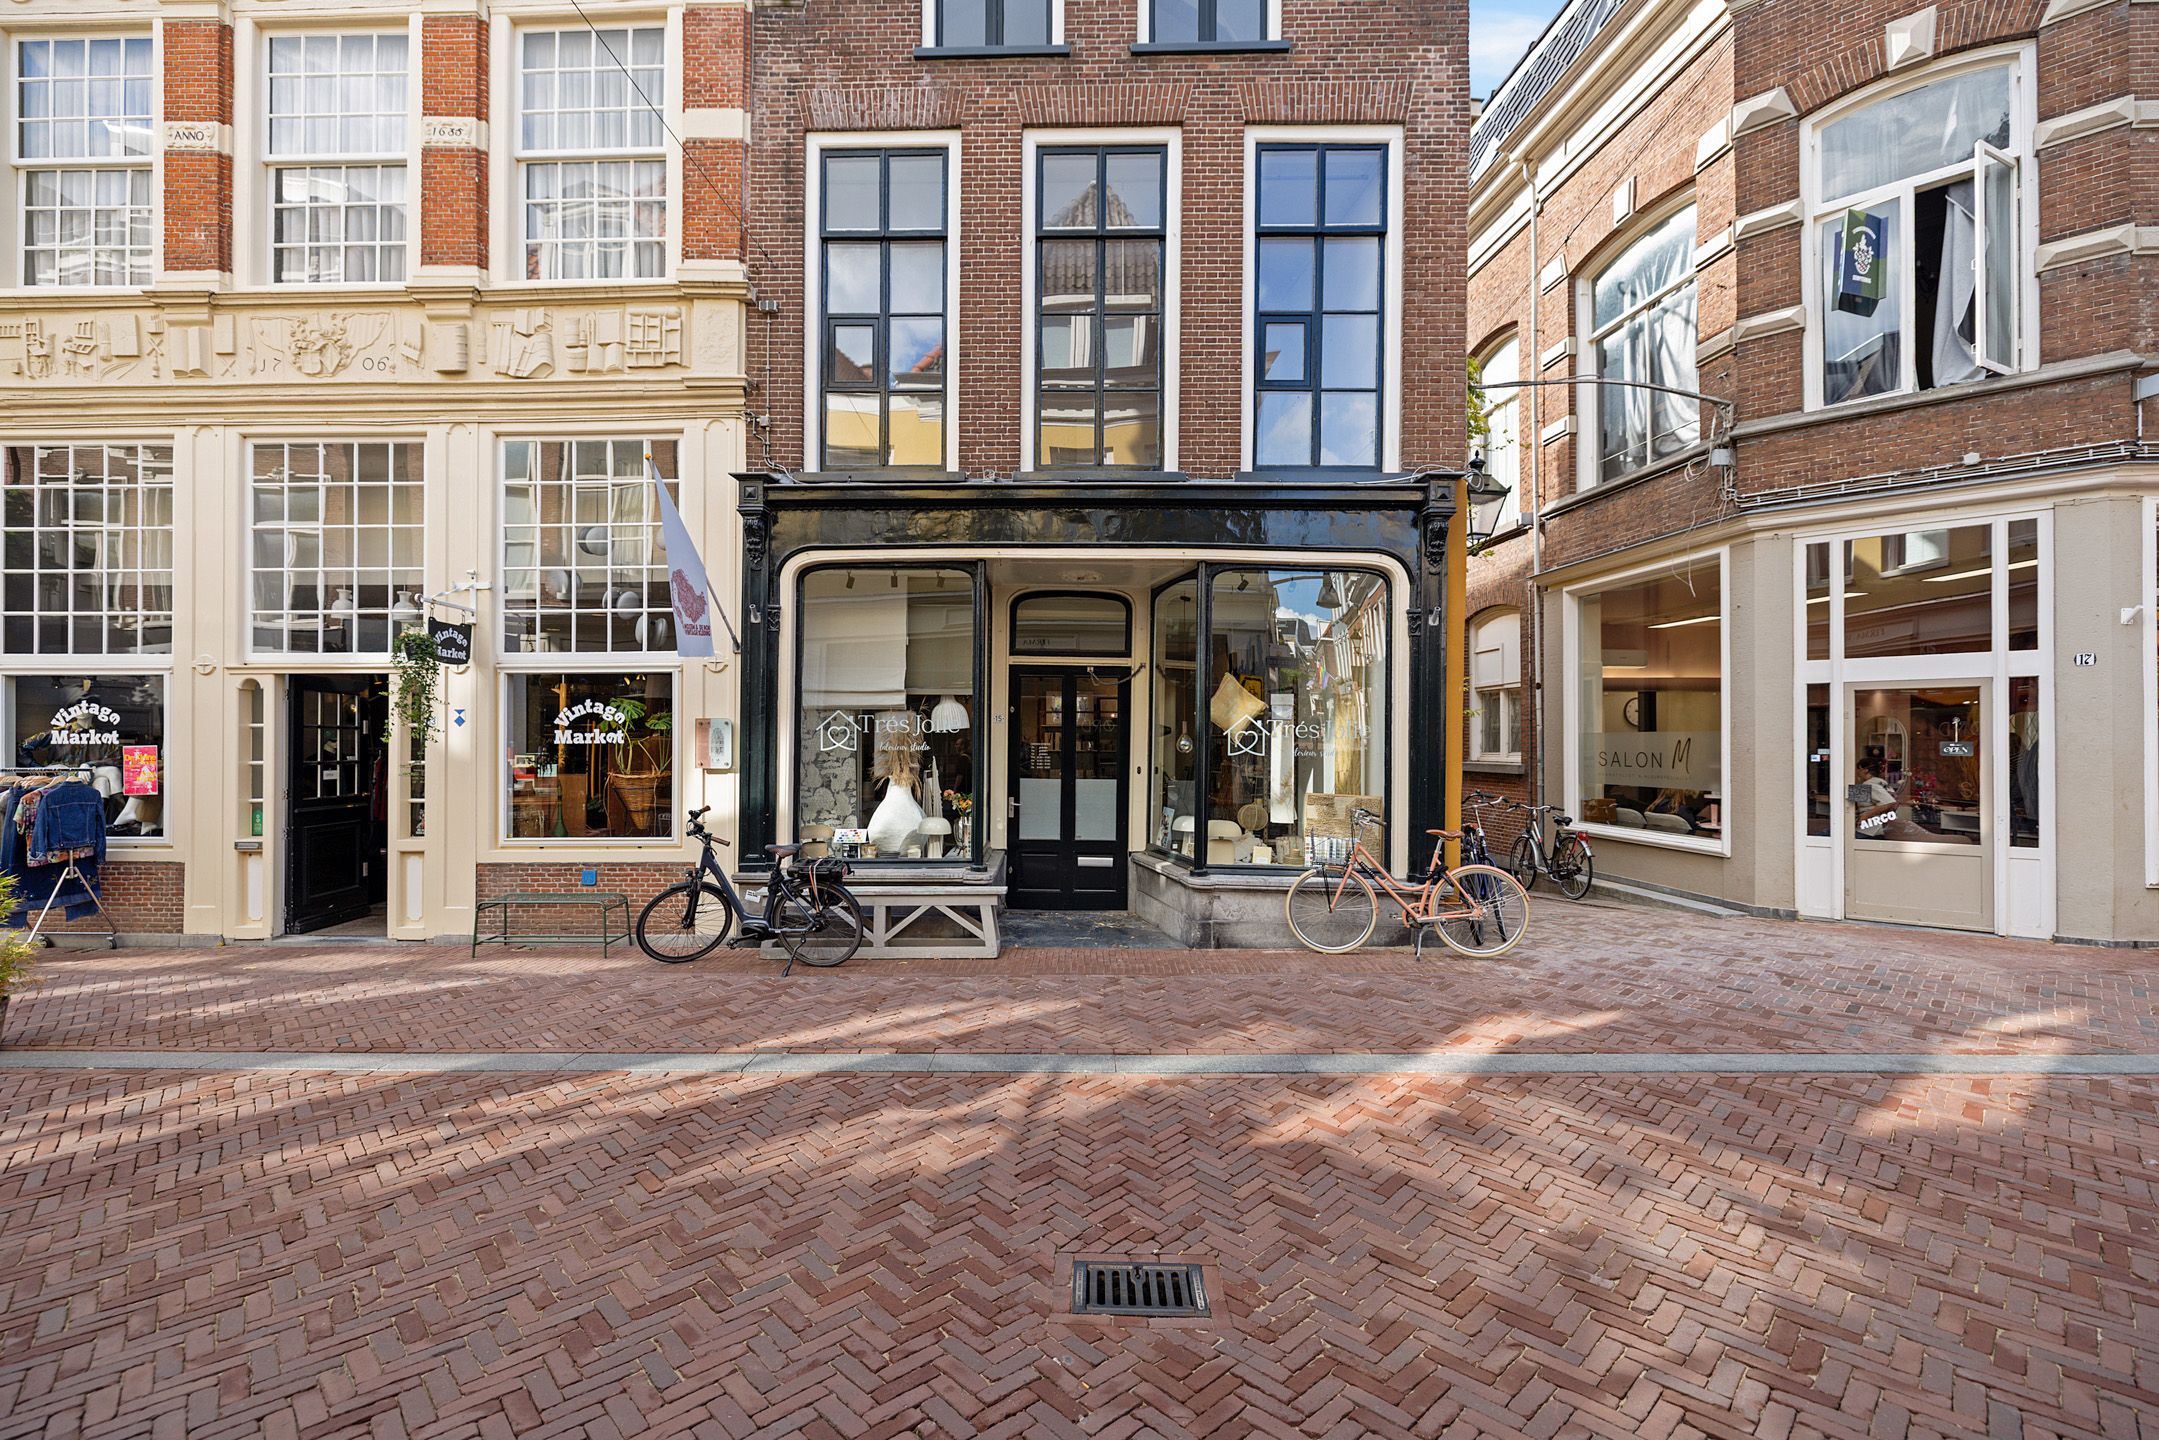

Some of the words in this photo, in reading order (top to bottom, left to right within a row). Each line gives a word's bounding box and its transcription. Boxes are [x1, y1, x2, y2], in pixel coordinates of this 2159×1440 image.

[174, 130, 206, 141] ANNO
[433, 627, 468, 647] Vintage
[2079, 653, 2092, 665] 17
[50, 700, 120, 727] Vintage
[553, 699, 626, 727] Vintage
[858, 714, 910, 734] Trés
[1266, 719, 1320, 739] Trés
[50, 729, 120, 745] Market
[553, 728, 625, 745] Market
[1598, 751, 1663, 768] SALON
[1671, 737, 1692, 775] M
[1943, 746, 1969, 754] OPEN
[1860, 810, 1897, 830] AIRCO
